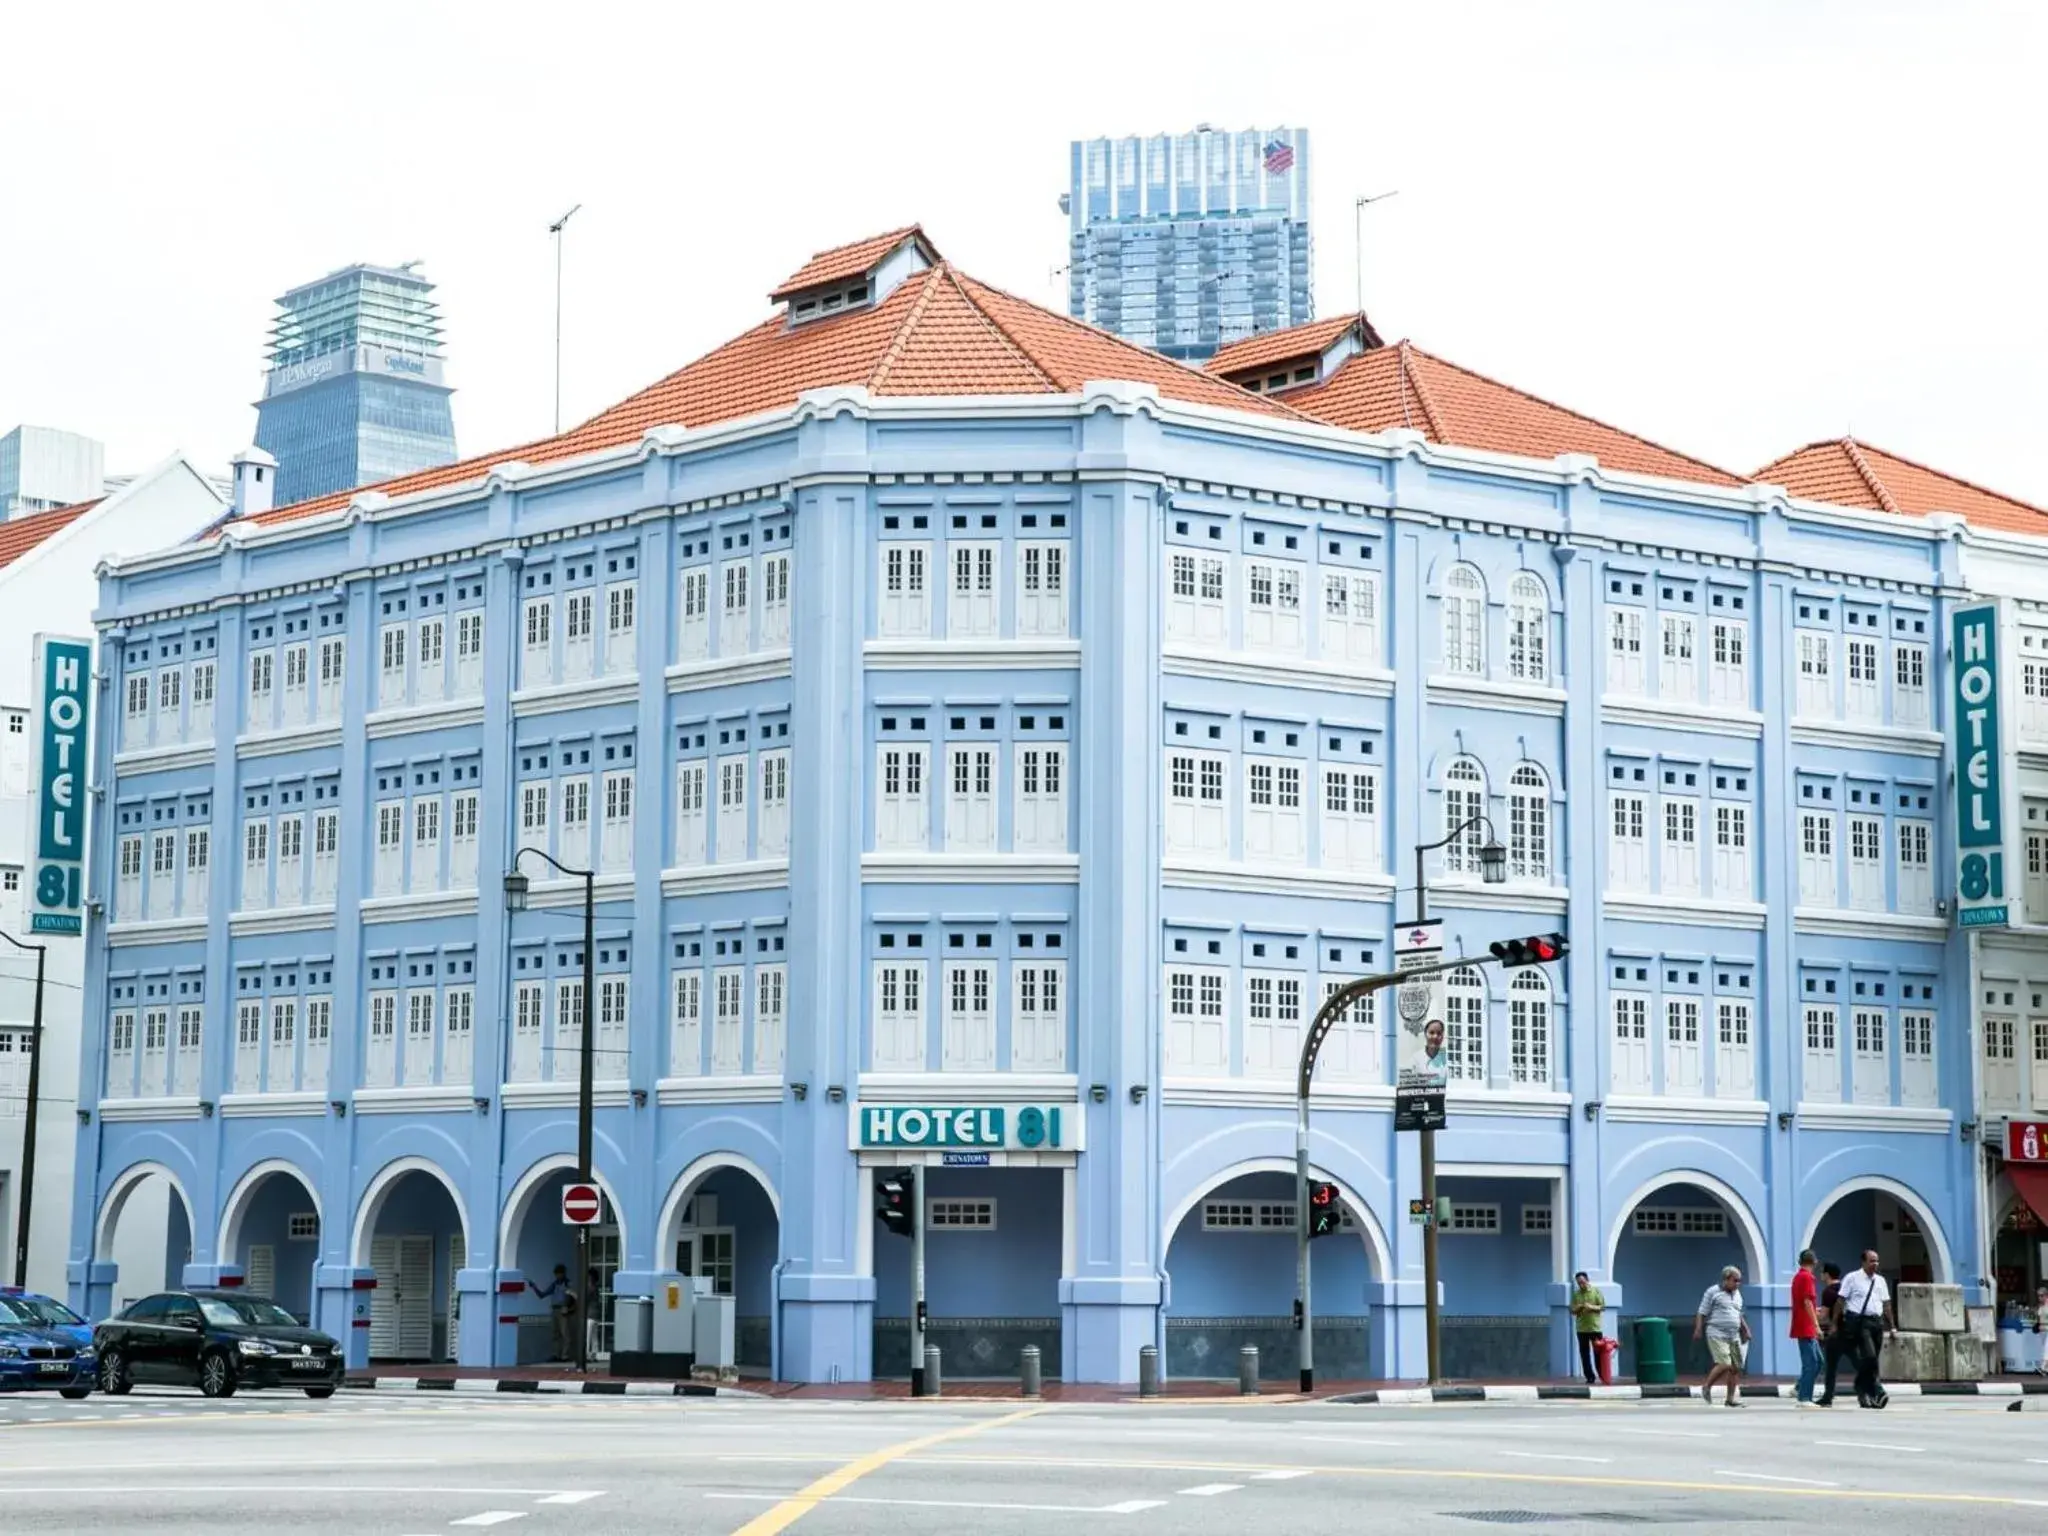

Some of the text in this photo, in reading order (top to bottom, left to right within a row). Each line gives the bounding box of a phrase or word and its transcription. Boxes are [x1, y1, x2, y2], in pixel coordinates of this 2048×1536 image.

[49, 656, 81, 846] HOTEL
[1960, 623, 1991, 831] HOTEL
[37, 864, 80, 909] 81
[1960, 852, 2003, 901] 81
[870, 1106, 1060, 1148] HOTEL 81
